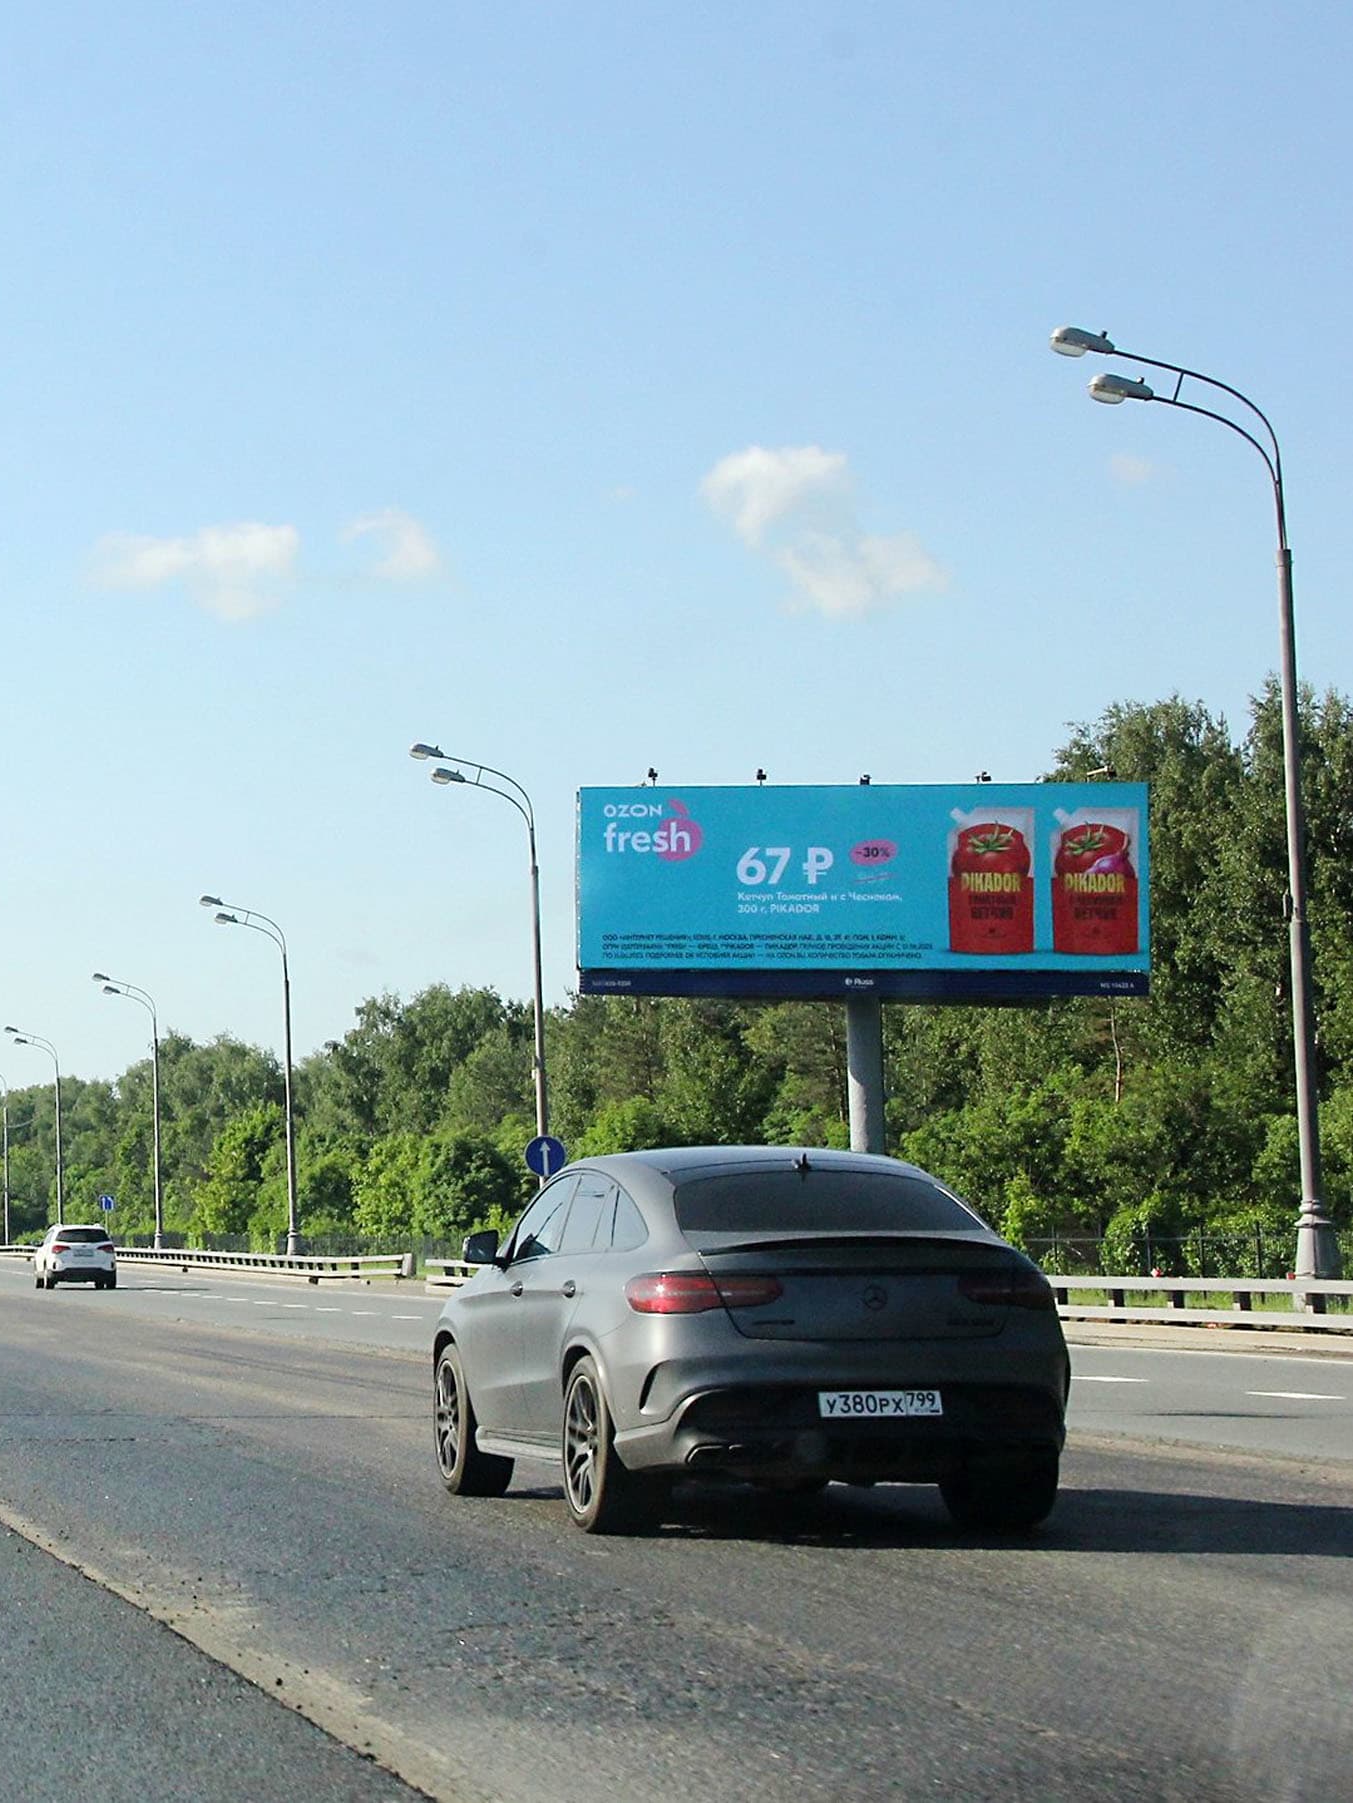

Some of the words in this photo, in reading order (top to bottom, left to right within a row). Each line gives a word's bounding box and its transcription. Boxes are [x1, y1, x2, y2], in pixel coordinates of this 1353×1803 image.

[603, 804, 662, 817] OZON
[603, 822, 690, 852] fresh
[855, 847, 890, 858] -30%
[736, 847, 790, 885] 67
[960, 872, 1021, 892] PIKADOR
[1064, 872, 1125, 893] PIKADOR
[737, 891, 774, 902] Кетчуп
[776, 891, 827, 901] Томатный
[770, 903, 820, 913] PIKADOR
[906, 1392, 935, 1407] 799
